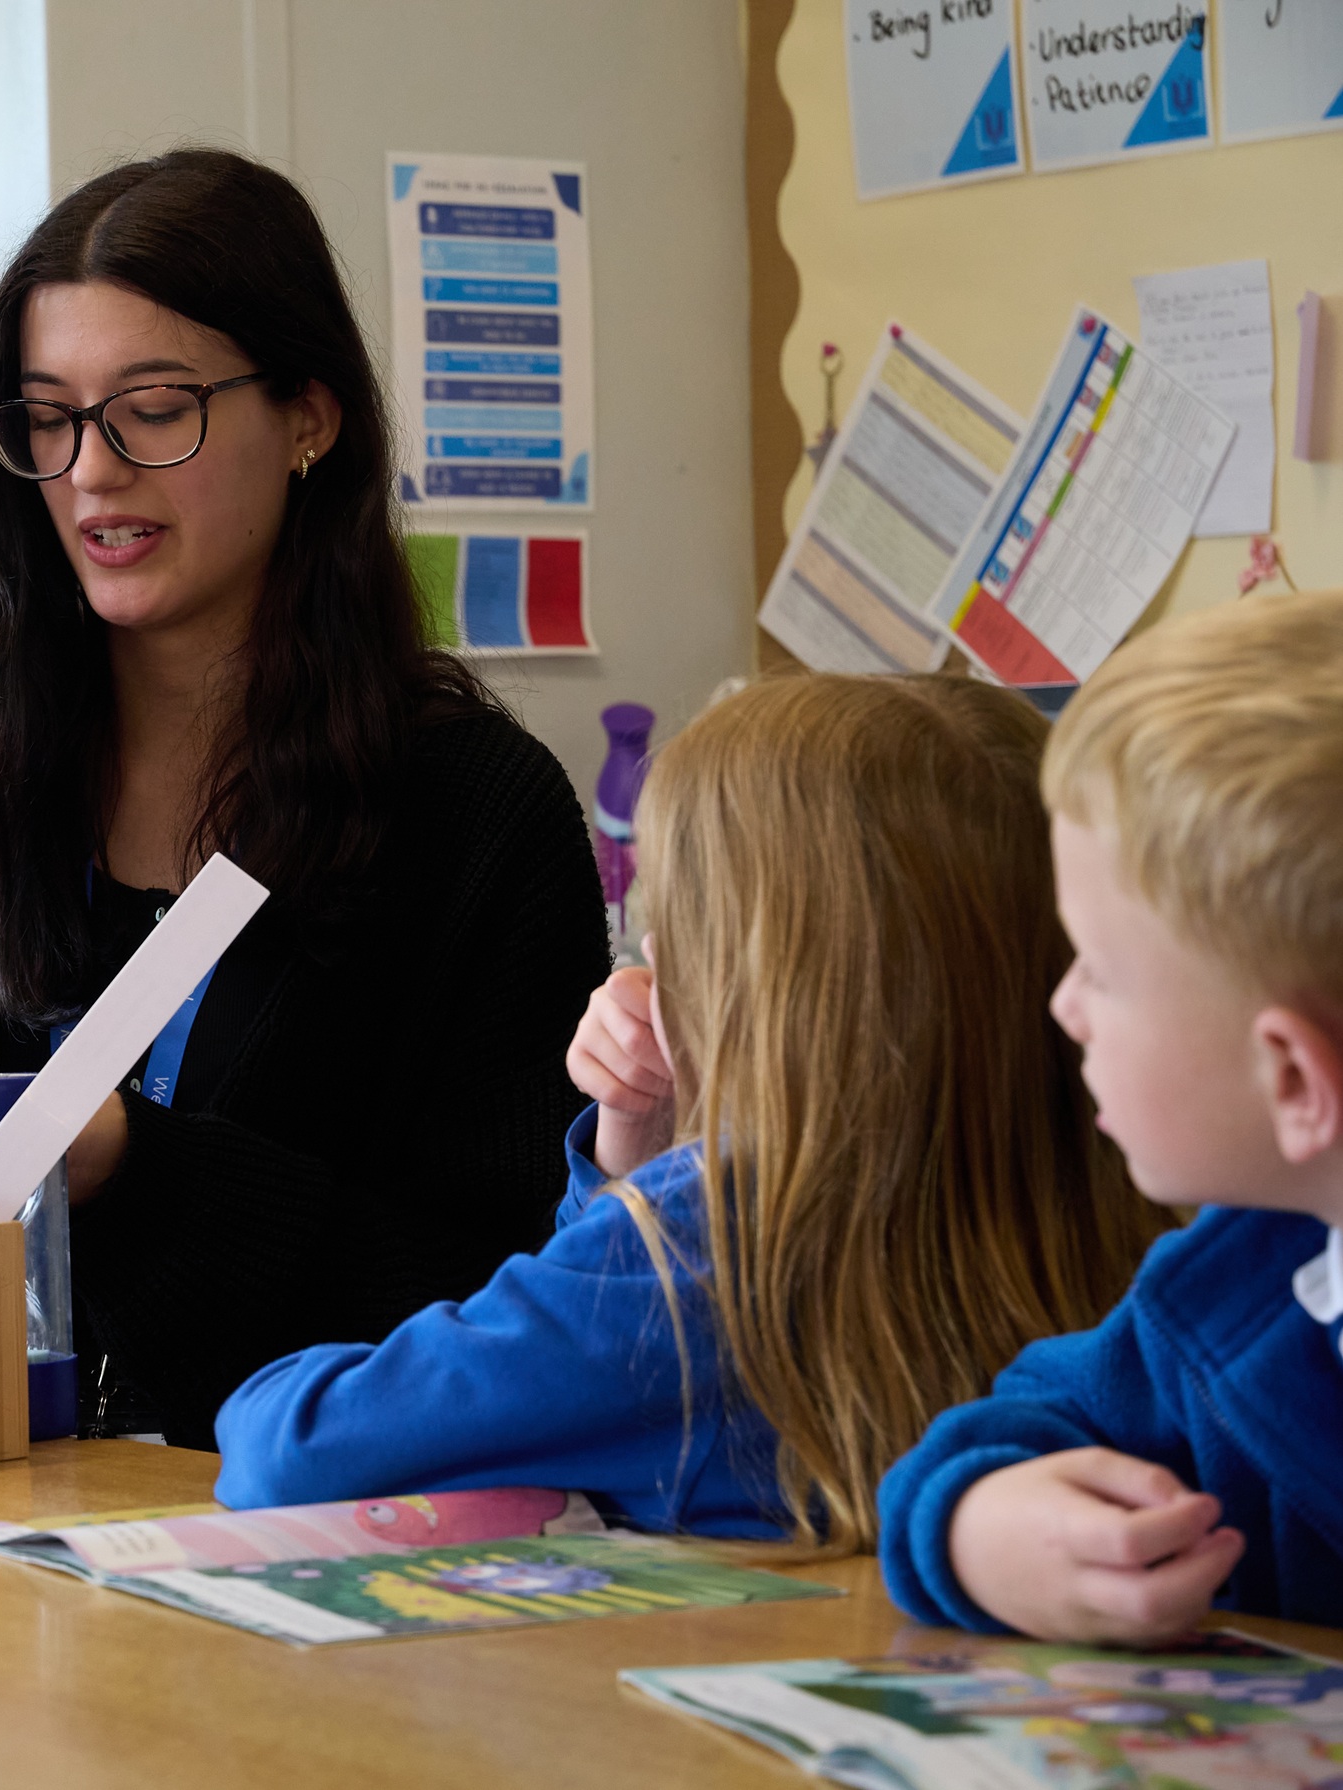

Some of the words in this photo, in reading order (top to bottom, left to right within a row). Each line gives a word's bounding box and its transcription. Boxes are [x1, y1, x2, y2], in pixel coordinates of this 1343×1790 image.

[869, 9, 930, 59] Being
[1038, 3, 1206, 62] Understanding
[1044, 73, 1151, 113] Patience
